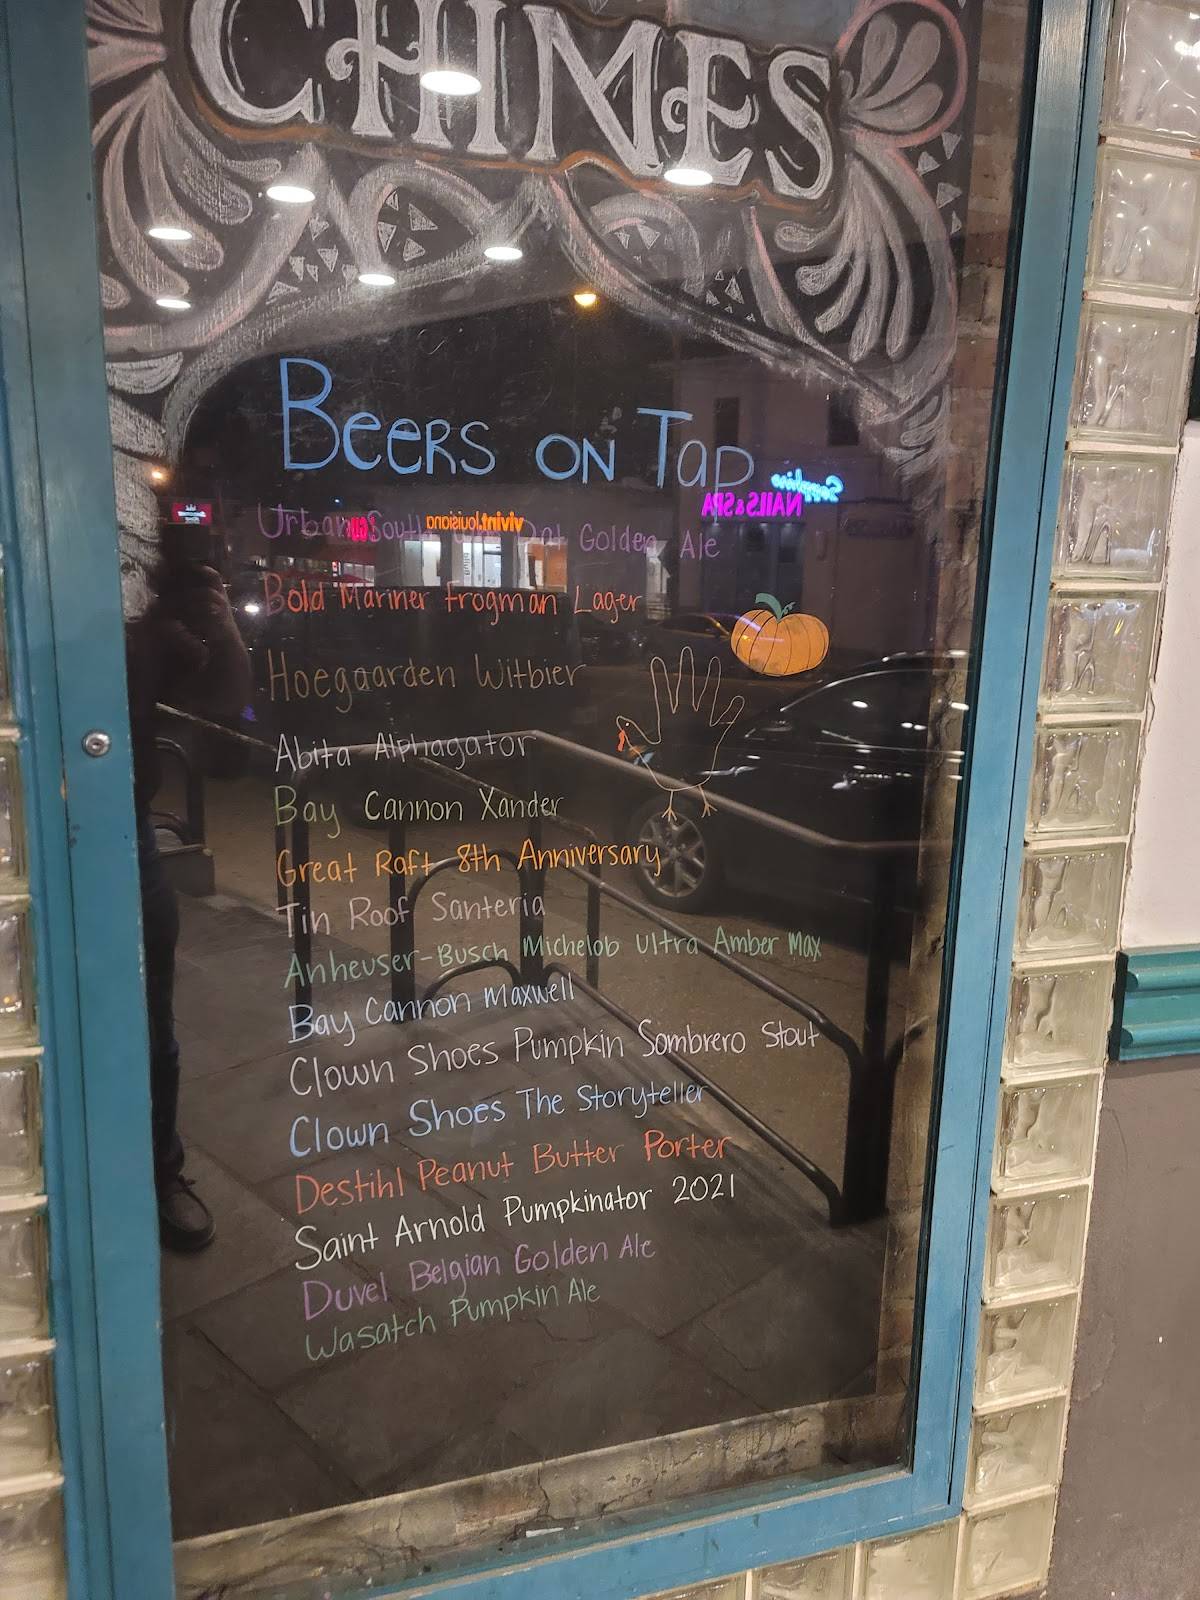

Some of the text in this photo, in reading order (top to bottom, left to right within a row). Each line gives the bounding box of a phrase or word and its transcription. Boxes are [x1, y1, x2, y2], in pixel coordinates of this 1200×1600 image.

[189, 0, 832, 199] CHIMES
[637, 407, 755, 527] Tap
[257, 502, 350, 539] Urban
[579, 523, 657, 553] Golden
[680, 529, 720, 560] Ale
[263, 573, 643, 625] Bold Mariner Frogman Lager
[268, 649, 587, 714] Hoegaarden Witbier
[275, 730, 536, 773] Abita Alphagator
[273, 785, 564, 841] Bay Cannon Xander
[276, 837, 662, 887] Great Raft 8th Anniversary
[276, 889, 546, 938] Tin Roof Santeria
[283, 944, 509, 989] Anheuser-Busch
[522, 934, 621, 958] Michelob
[636, 931, 699, 956] Ultra
[713, 926, 780, 959] Amber
[288, 972, 575, 1046] Bay Cannon Maxwell
[290, 1018, 821, 1098] Clown Shoes Pumpkin Sombrero Stout
[289, 1082, 706, 1158] Clown Shoes The Storyteller
[417, 1151, 514, 1190] Peanut
[532, 1140, 624, 1176] Butter
[643, 1127, 732, 1163] Porter
[295, 1174, 736, 1271] Saint Arnold Pumpkinator 2021
[302, 1233, 656, 1321] Duvel Belgian Golden Ale
[306, 1277, 602, 1361] Wasatch Pumpkin Ale
